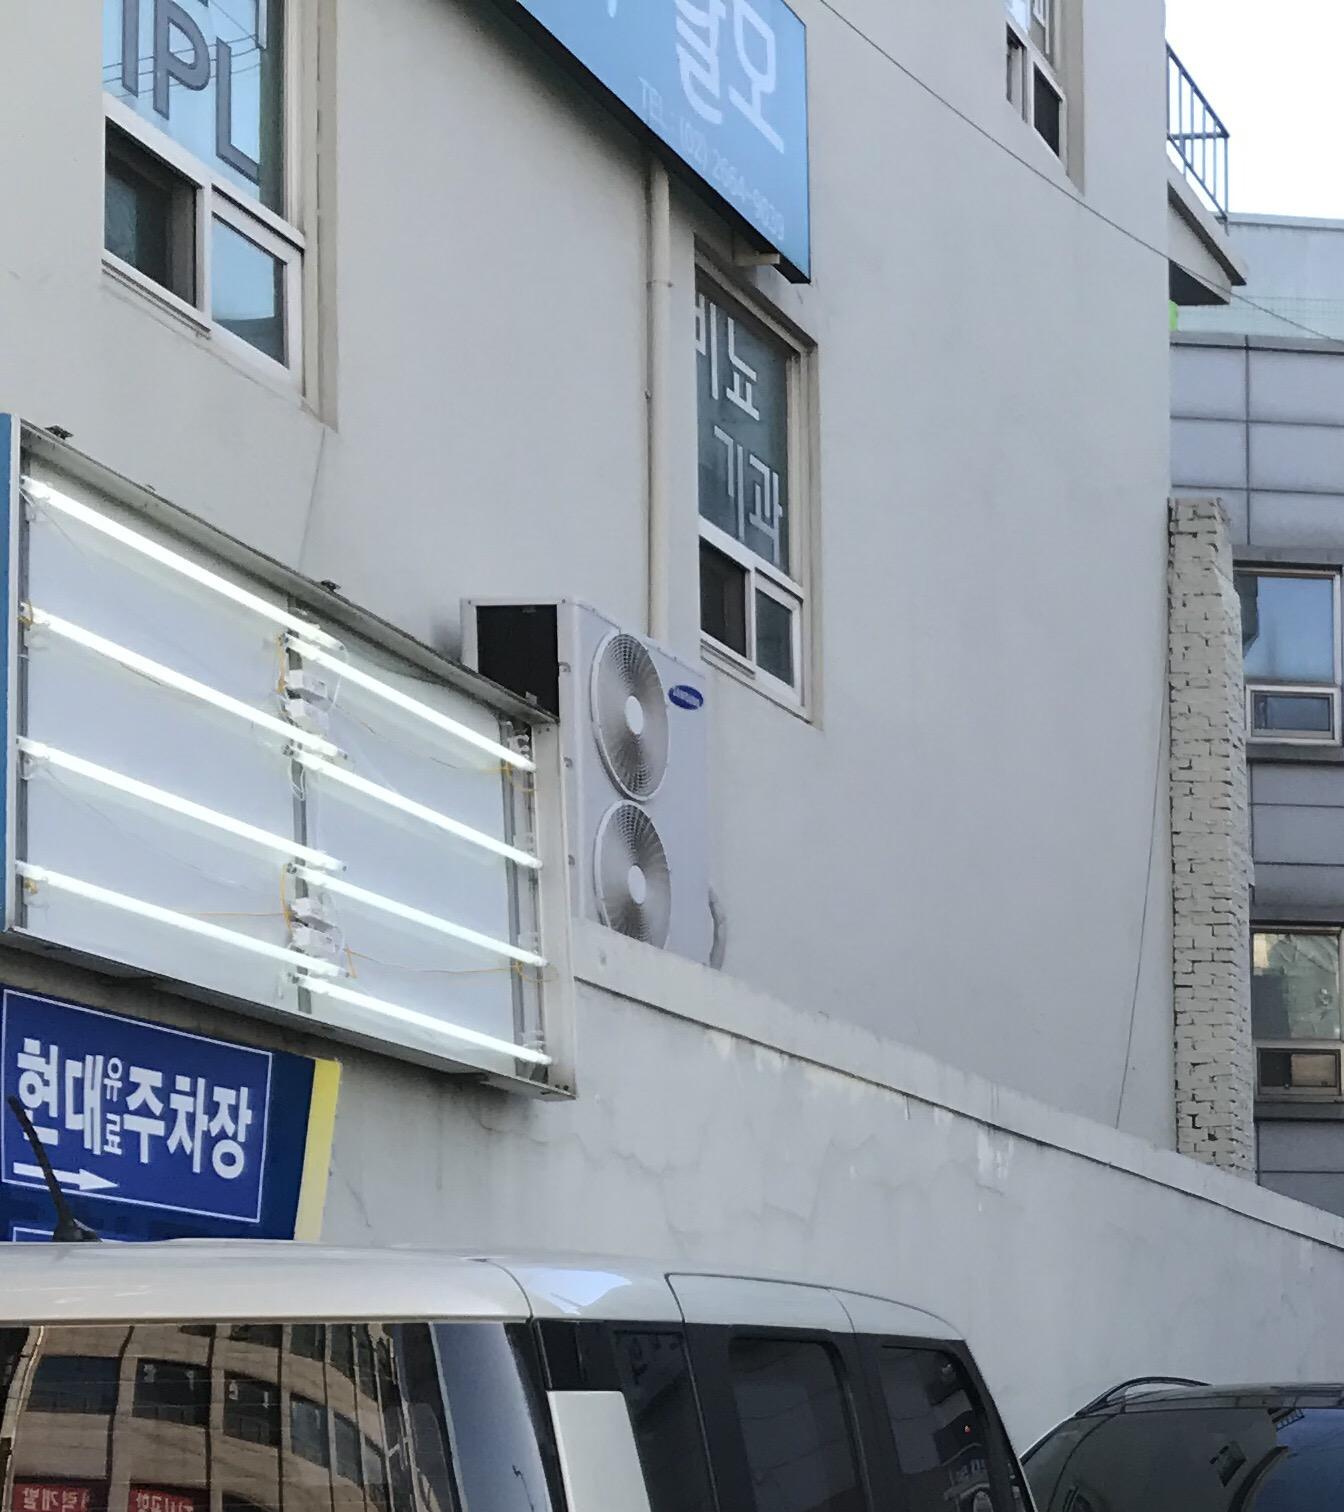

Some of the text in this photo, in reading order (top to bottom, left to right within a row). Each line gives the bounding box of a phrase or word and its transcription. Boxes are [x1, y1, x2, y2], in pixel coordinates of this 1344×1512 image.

[121, 0, 262, 188] IPL
[17, 1038, 104, 1155] 현대
[122, 1065, 253, 1180] 주차장
